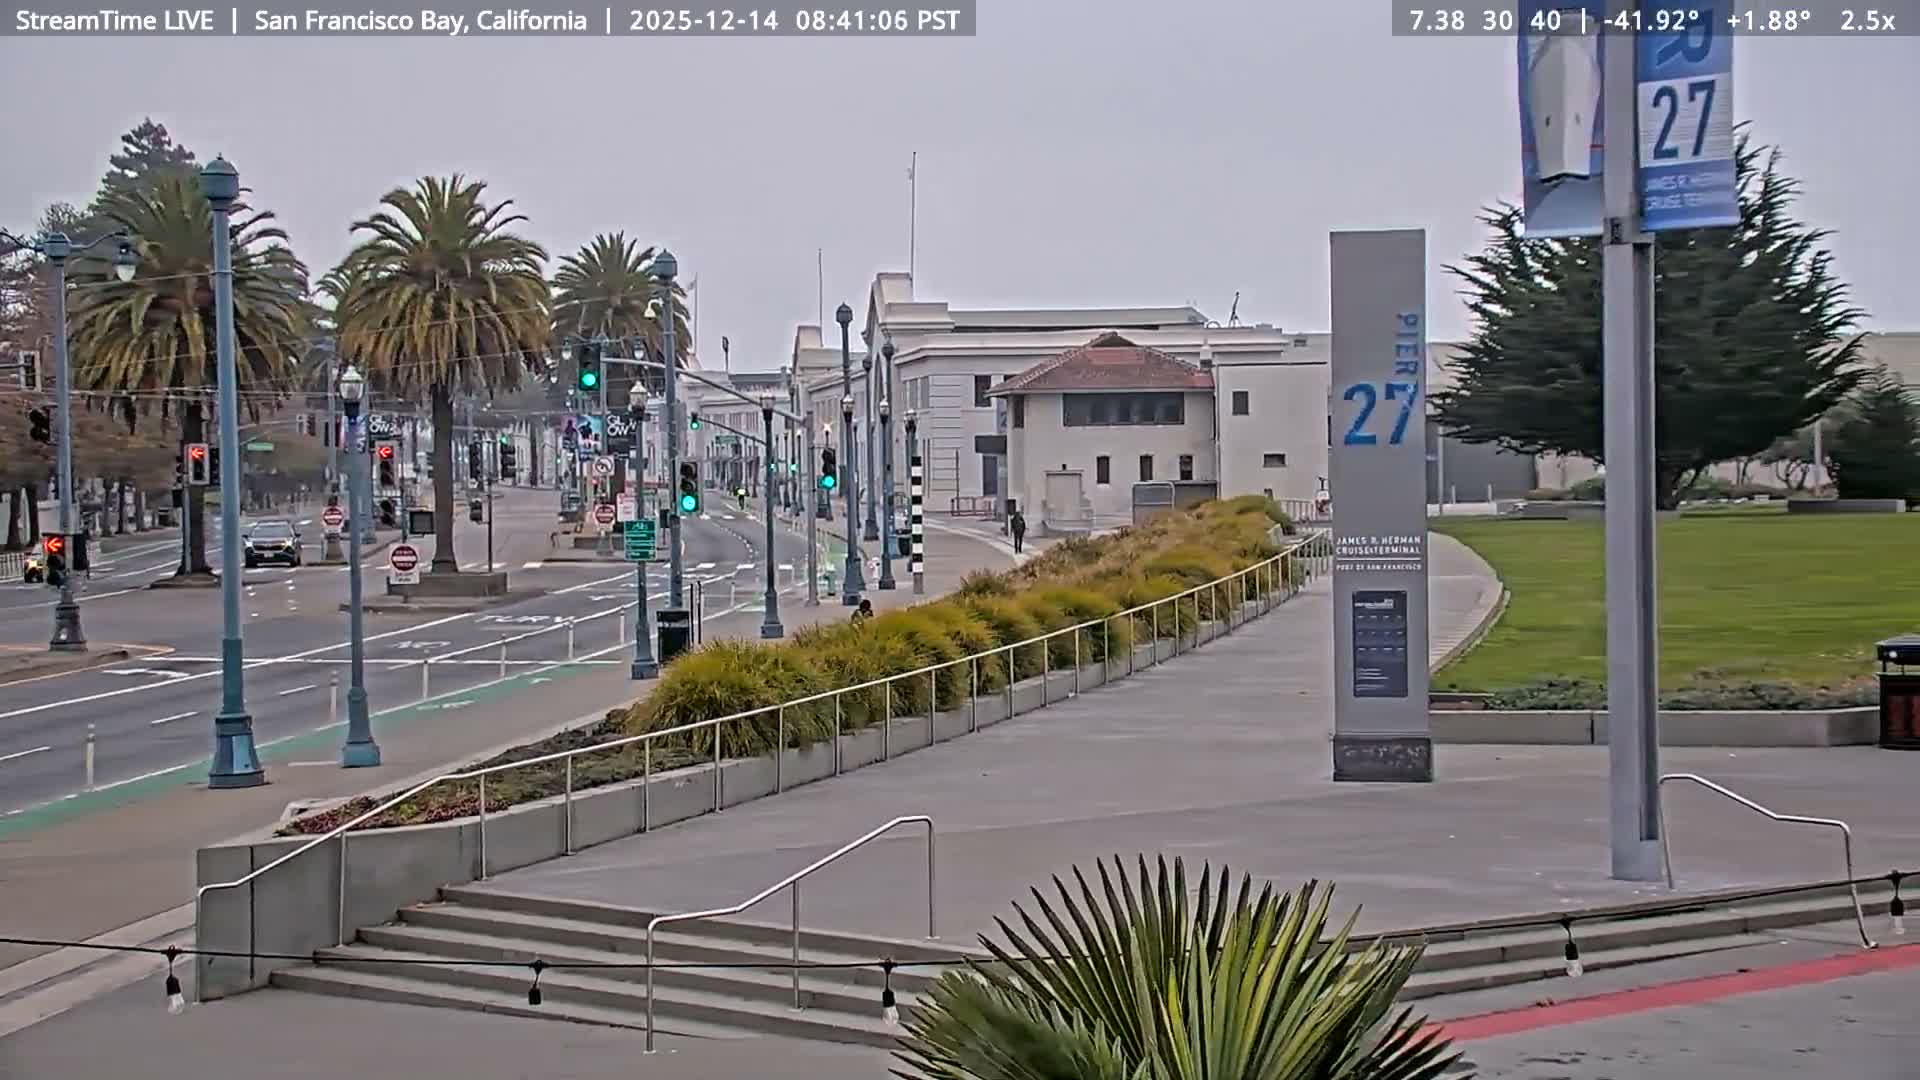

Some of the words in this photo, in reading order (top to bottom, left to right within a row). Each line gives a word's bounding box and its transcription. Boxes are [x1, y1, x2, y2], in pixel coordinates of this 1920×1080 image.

[1651, 79, 1716, 160] 27
[1395, 312, 1419, 375] PIER
[1343, 383, 1419, 446] 27
[1335, 545, 1369, 555] CRUISE
[1373, 545, 1421, 555] TERMINAL
[1336, 536, 1367, 545] JAMES
[1381, 535, 1421, 545] HERMAN
